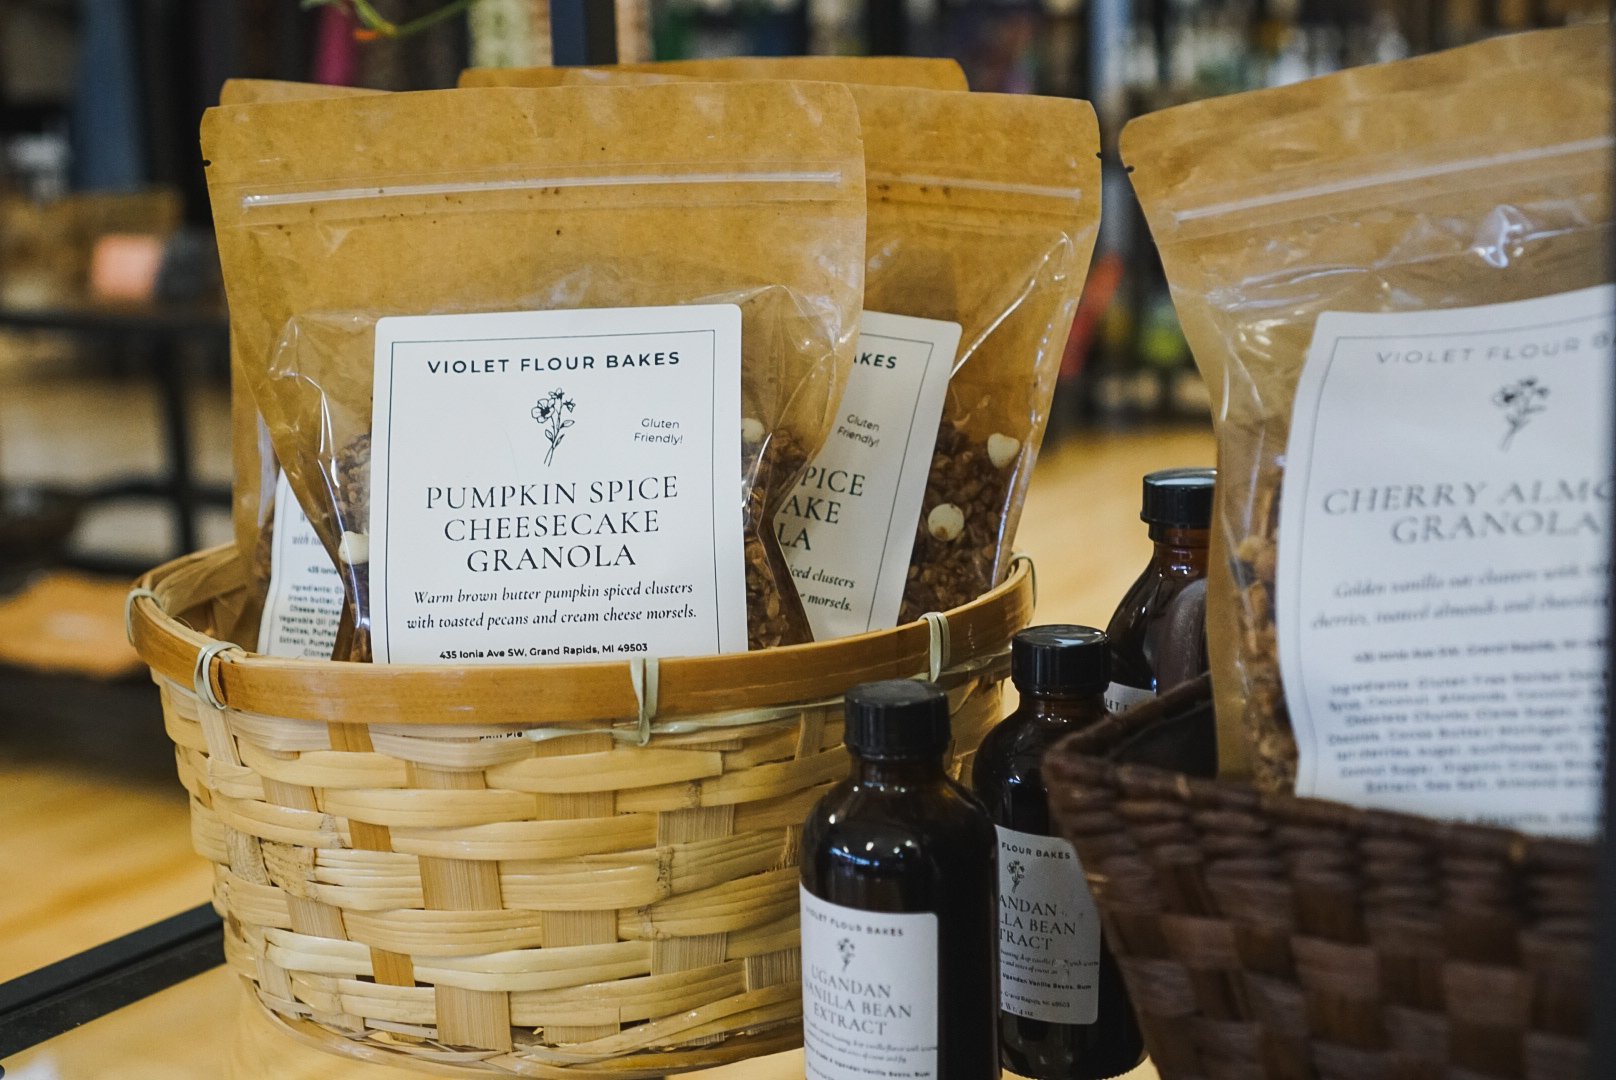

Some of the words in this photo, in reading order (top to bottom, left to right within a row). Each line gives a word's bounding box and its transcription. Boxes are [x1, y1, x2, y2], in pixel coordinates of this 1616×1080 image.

[427, 359, 510, 374] VIOLET
[520, 355, 595, 372] FLOUR
[606, 351, 681, 368] BAKES
[1376, 347, 1474, 365] VIOLET
[641, 417, 680, 430] Gluten
[846, 413, 880, 432] Gluten
[633, 432, 684, 445] Friendly!
[836, 426, 880, 448] Friendly!
[426, 482, 577, 510] PUMPKIN
[589, 475, 678, 504] SPICE
[1323, 481, 1487, 516] CHERRY
[444, 509, 660, 542] CHEESECAKE
[1391, 510, 1601, 545] GRANOLA
[466, 543, 637, 573] GRANOLA
[812, 571, 855, 589] clusters
[414, 590, 453, 604] Warm
[457, 588, 498, 603] brown
[502, 586, 541, 601] butter
[544, 583, 599, 603] pumpkin
[603, 580, 641, 601] spiced
[645, 580, 693, 596] clusters
[807, 594, 853, 613] morsels.
[406, 613, 434, 629] with
[439, 612, 484, 628] toasted
[487, 612, 529, 631] pecans
[532, 609, 558, 624] and
[561, 610, 599, 624] cream
[603, 606, 643, 622] cheese
[646, 603, 697, 620] morsels.
[439, 650, 457, 659] 435
[459, 649, 484, 659] Ionia
[486, 648, 505, 658] Ave
[507, 647, 527, 658] SW,
[529, 645, 560, 656] Grand
[563, 643, 600, 657] Rapids,
[602, 643, 614, 653] MI
[617, 642, 648, 653] 49503
[1001, 841, 1032, 856] FLOUR
[1036, 848, 1071, 860] BAKES
[866, 927, 904, 938] BAKES
[1029, 918, 1076, 935] BEAN
[811, 964, 891, 999] UGANDAN
[813, 1002, 887, 1036] EXTRACT
[862, 1002, 912, 1019] BEAN
